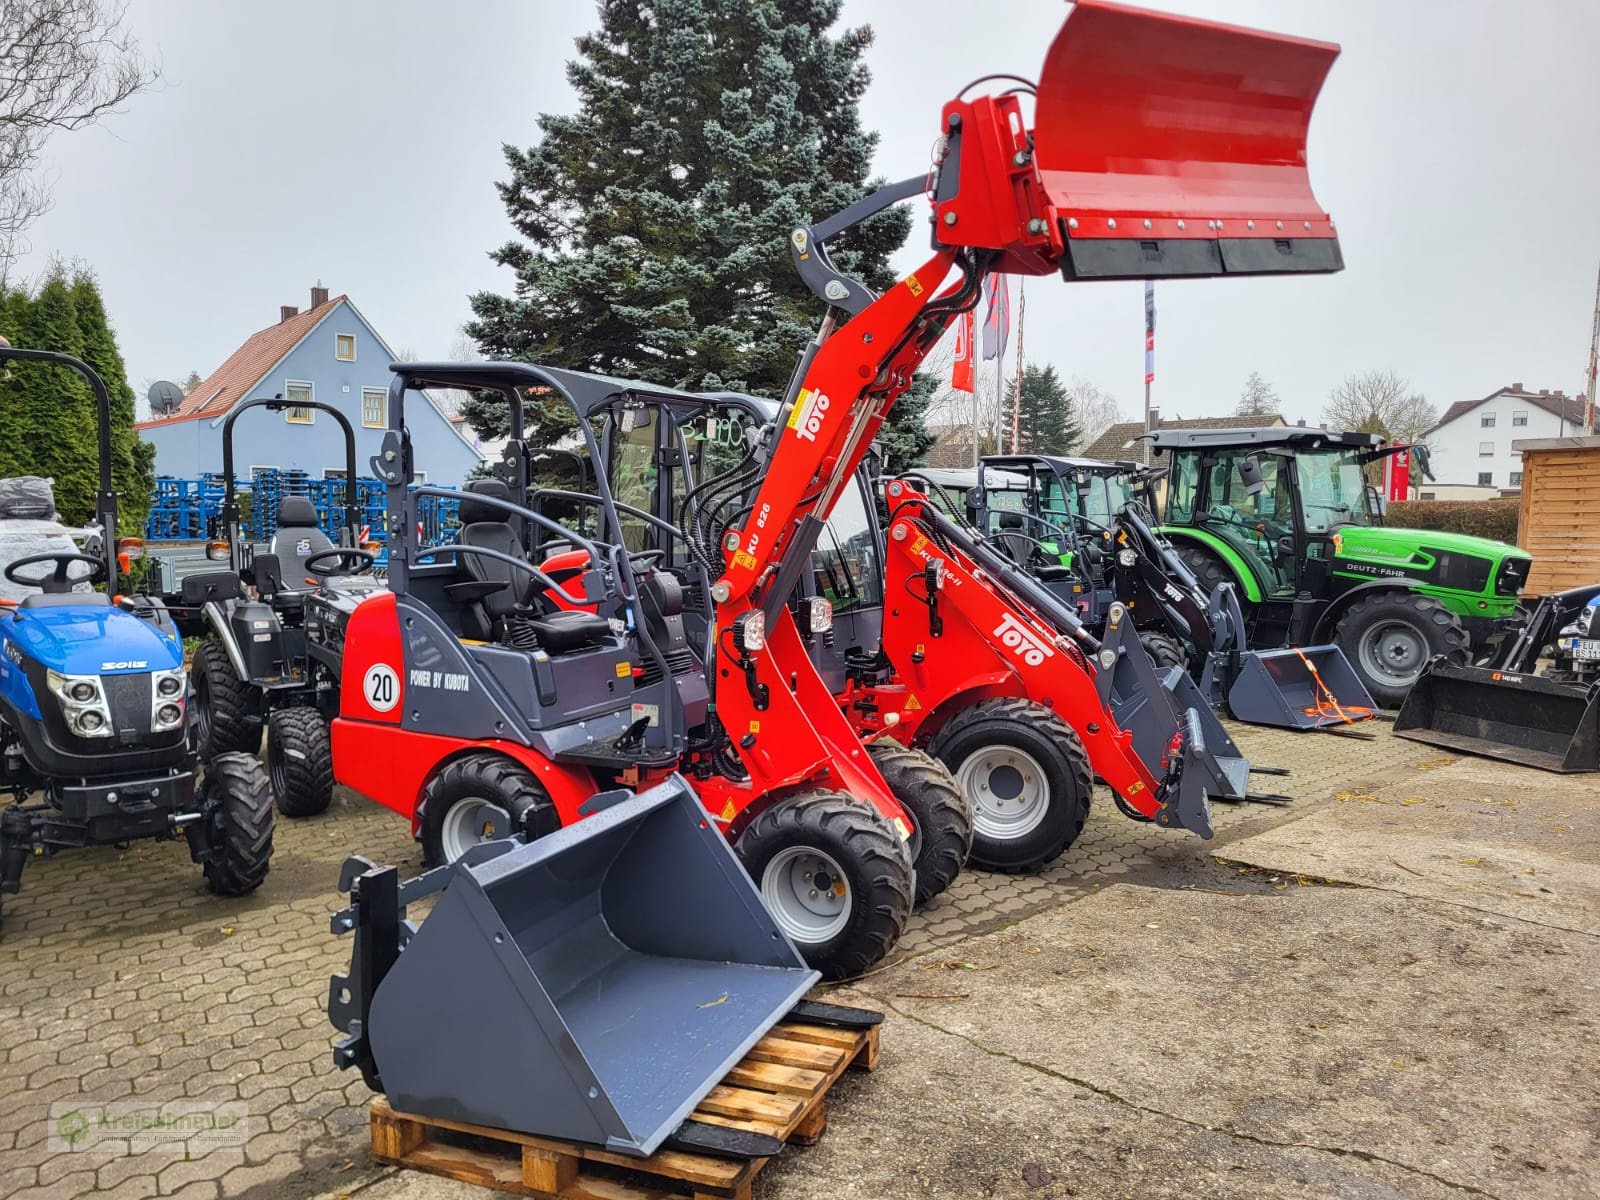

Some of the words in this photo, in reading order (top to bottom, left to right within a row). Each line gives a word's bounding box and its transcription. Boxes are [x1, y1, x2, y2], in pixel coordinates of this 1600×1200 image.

[797, 387, 830, 443] TOYO
[747, 533, 760, 556] KU
[756, 502, 771, 529] 826
[1164, 583, 1185, 602] TOYO
[993, 612, 1055, 666] TOYO
[372, 673, 392, 702] 20
[410, 669, 431, 688] POWER
[433, 671, 442, 688] BY
[444, 673, 469, 691] KUBOTA
